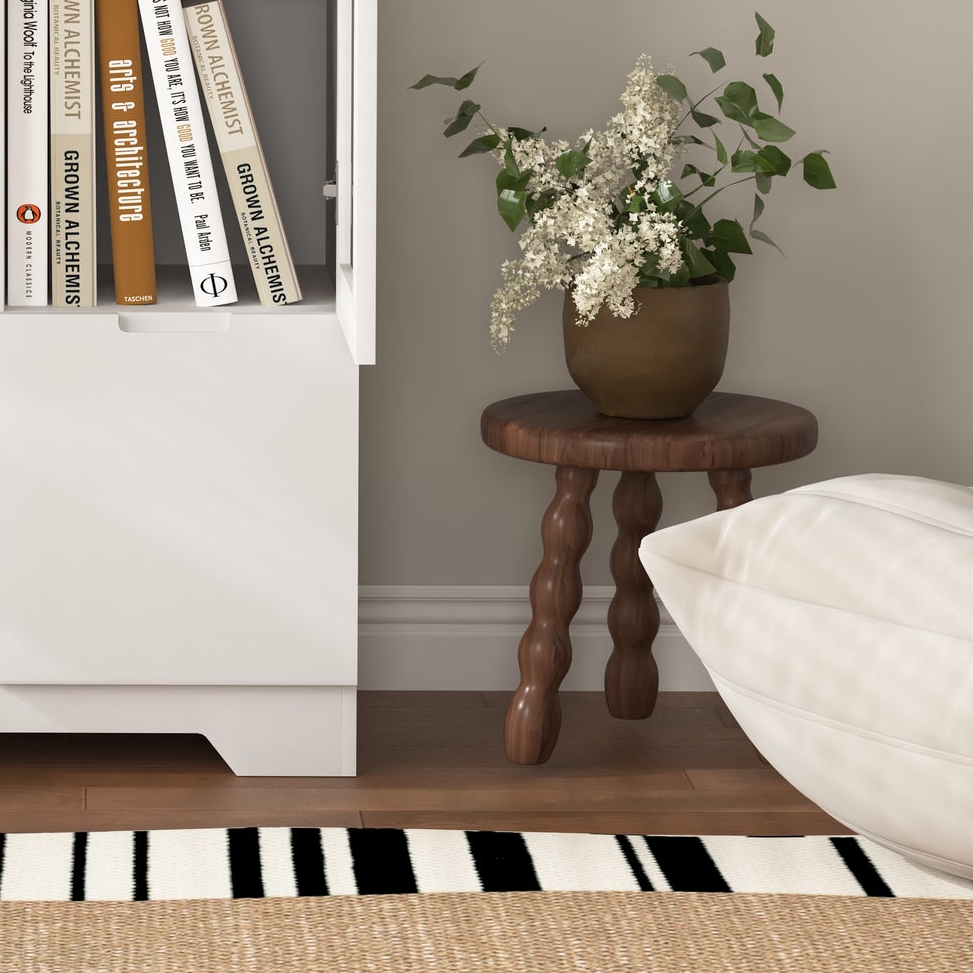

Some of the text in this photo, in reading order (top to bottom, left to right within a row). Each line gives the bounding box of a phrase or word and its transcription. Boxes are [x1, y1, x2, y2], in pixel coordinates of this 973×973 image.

[153, 4, 170, 18] NOT
[23, 21, 37, 47] Woolf
[157, 20, 173, 36] HOW
[160, 37, 177, 56] GOOD
[64, 29, 81, 119] ALCHEMIST
[164, 57, 180, 72] YOU
[194, 4, 244, 135] ROWN ALCHEMIST
[20, 51, 34, 114] To the Lighthouse
[109, 59, 137, 92] arts
[167, 74, 183, 90] ARE,
[171, 91, 186, 105] IT'S
[173, 106, 189, 122] HOW
[177, 123, 194, 142] GOOD
[180, 143, 197, 158] YOU
[112, 120, 145, 222] architecture
[183, 159, 201, 179] WANT
[187, 180, 203, 190] TO
[190, 192, 205, 204] BE.
[64, 150, 81, 307] GROWN ALCHEMIS
[194, 214, 214, 252] Paul Arden
[237, 163, 287, 305] GROWN ALCHEMIS
[241, 212, 260, 270] BOTANICAL BEAUTY
[124, 295, 153, 303] TASCHEN
